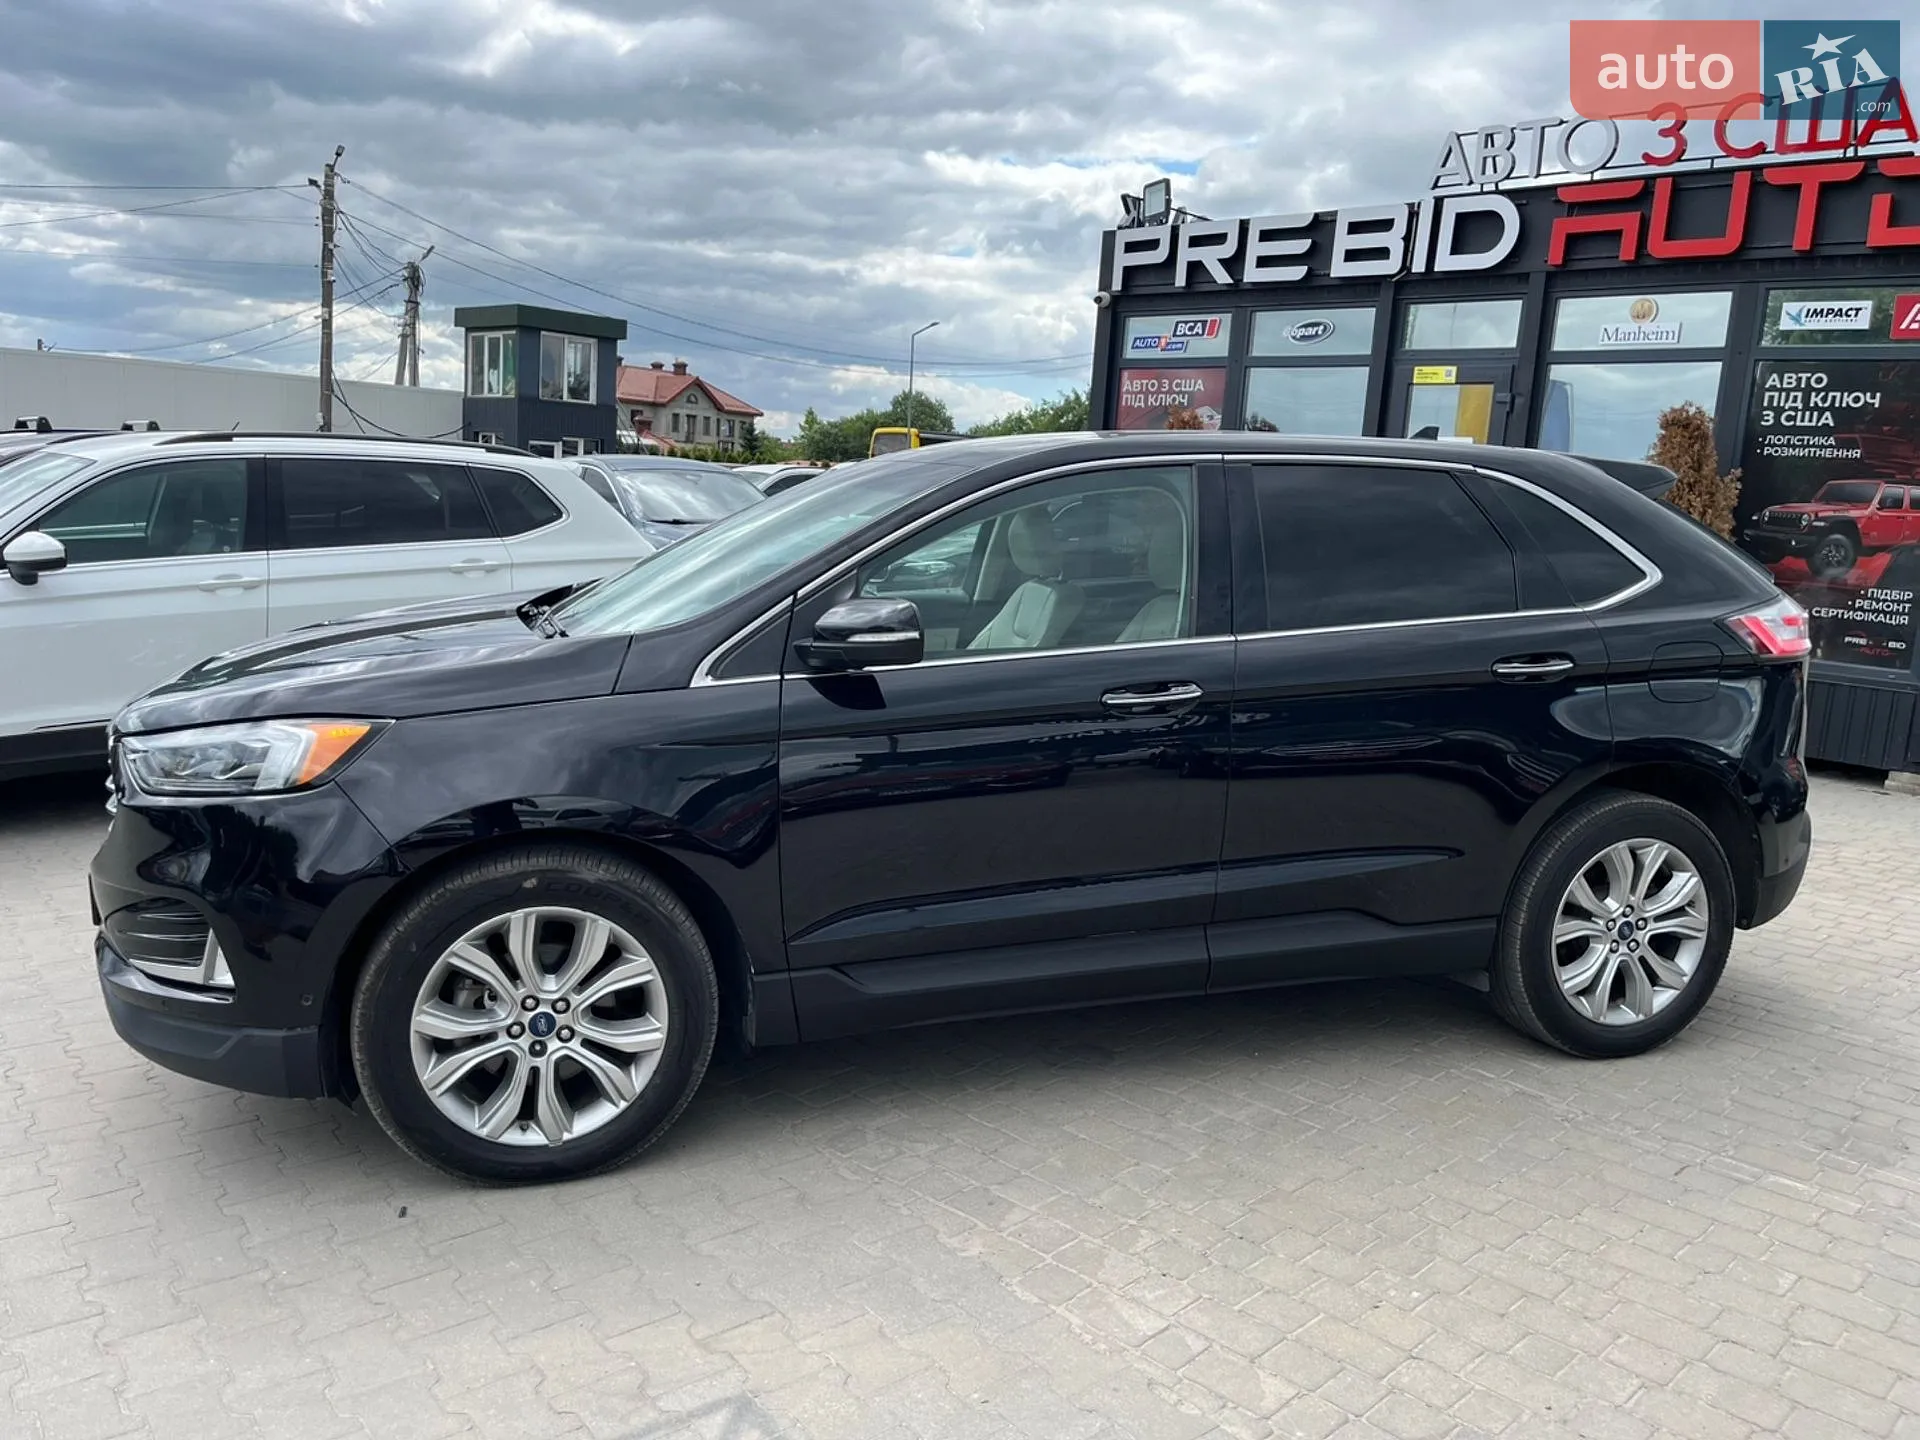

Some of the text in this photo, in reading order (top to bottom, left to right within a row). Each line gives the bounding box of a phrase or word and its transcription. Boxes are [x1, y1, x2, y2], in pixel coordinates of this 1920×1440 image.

[1429, 114, 1619, 190] АВТО
[1713, 77, 1919, 159] США
[1804, 307, 1863, 319] IMPACT
[1175, 322, 1204, 336] BCA
[1600, 324, 1676, 342] Manheim
[1123, 380, 1205, 392] АВТО З США
[1764, 373, 1829, 388] АВТО
[1122, 394, 1188, 408] ПІД КЛЮЧ
[1763, 391, 1882, 409] ПІД КЛЮЧ
[1760, 410, 1835, 427] З США
[1764, 434, 1836, 446] ЛОГІСТИКА
[1763, 446, 1862, 459] РОЗМИТНЕННЯ
[1867, 588, 1914, 601] ПІДБІР
[1855, 599, 1912, 613] РЕМОНТ
[1811, 607, 1910, 626] СЕРТИФІКАЦІЯ
